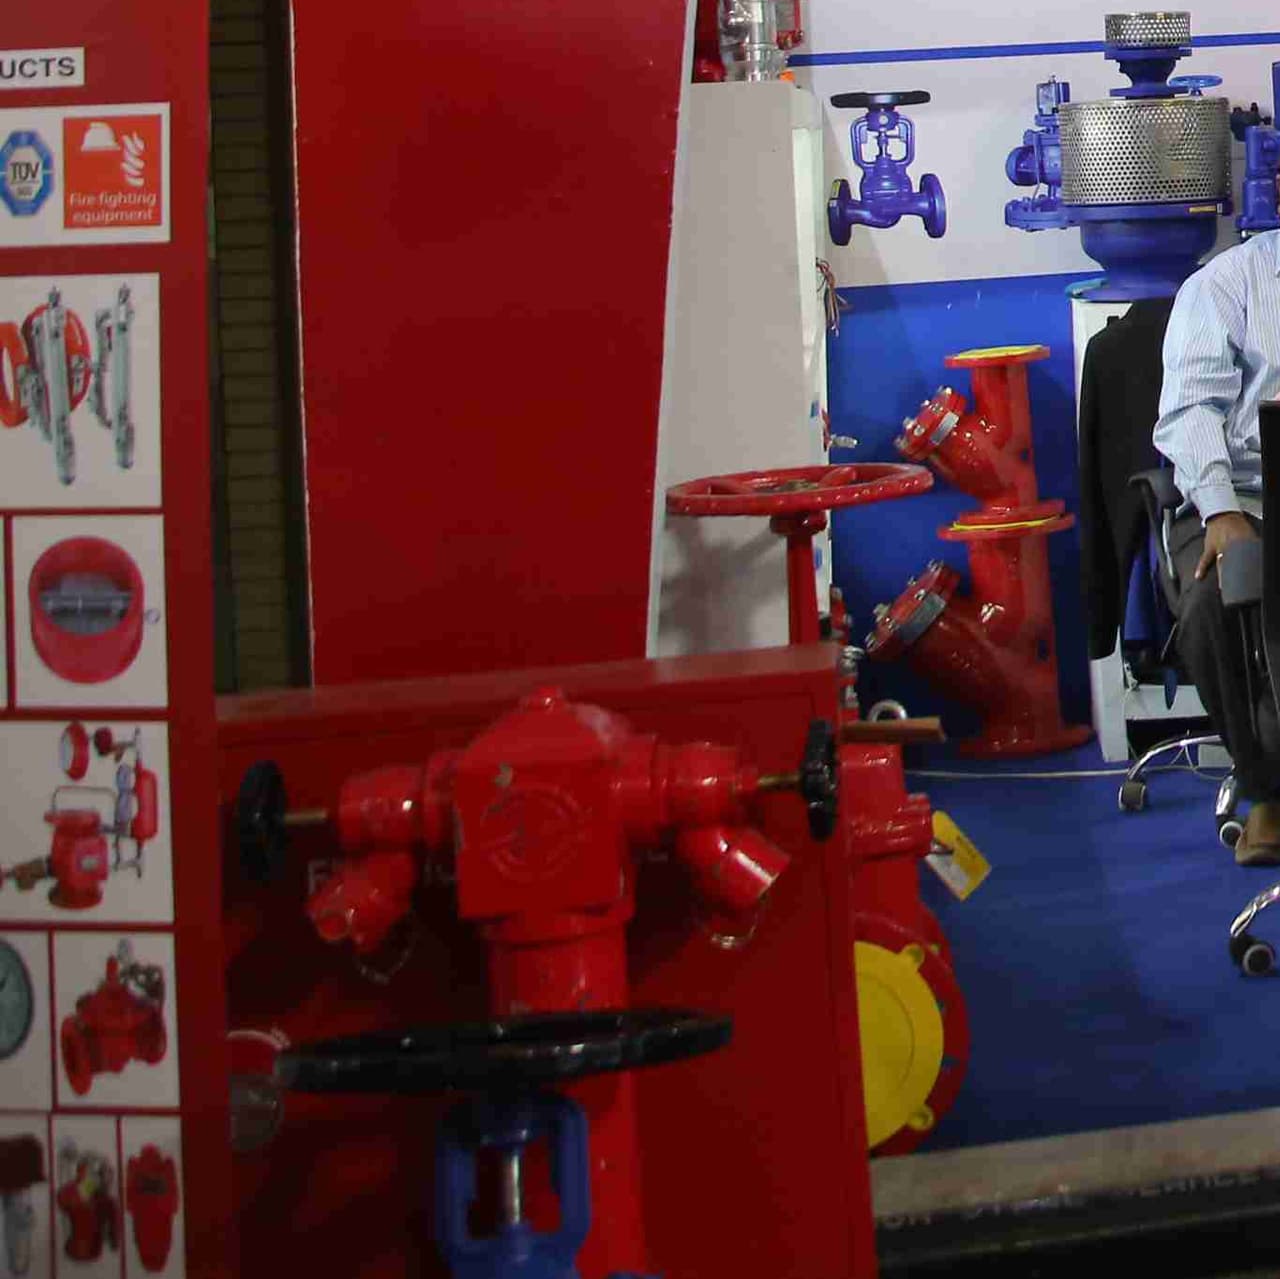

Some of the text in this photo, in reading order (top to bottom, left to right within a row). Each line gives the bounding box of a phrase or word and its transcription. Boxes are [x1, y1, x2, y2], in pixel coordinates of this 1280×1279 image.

[70, 190, 157, 211] Fire fighting
[73, 208, 153, 226] equipment
